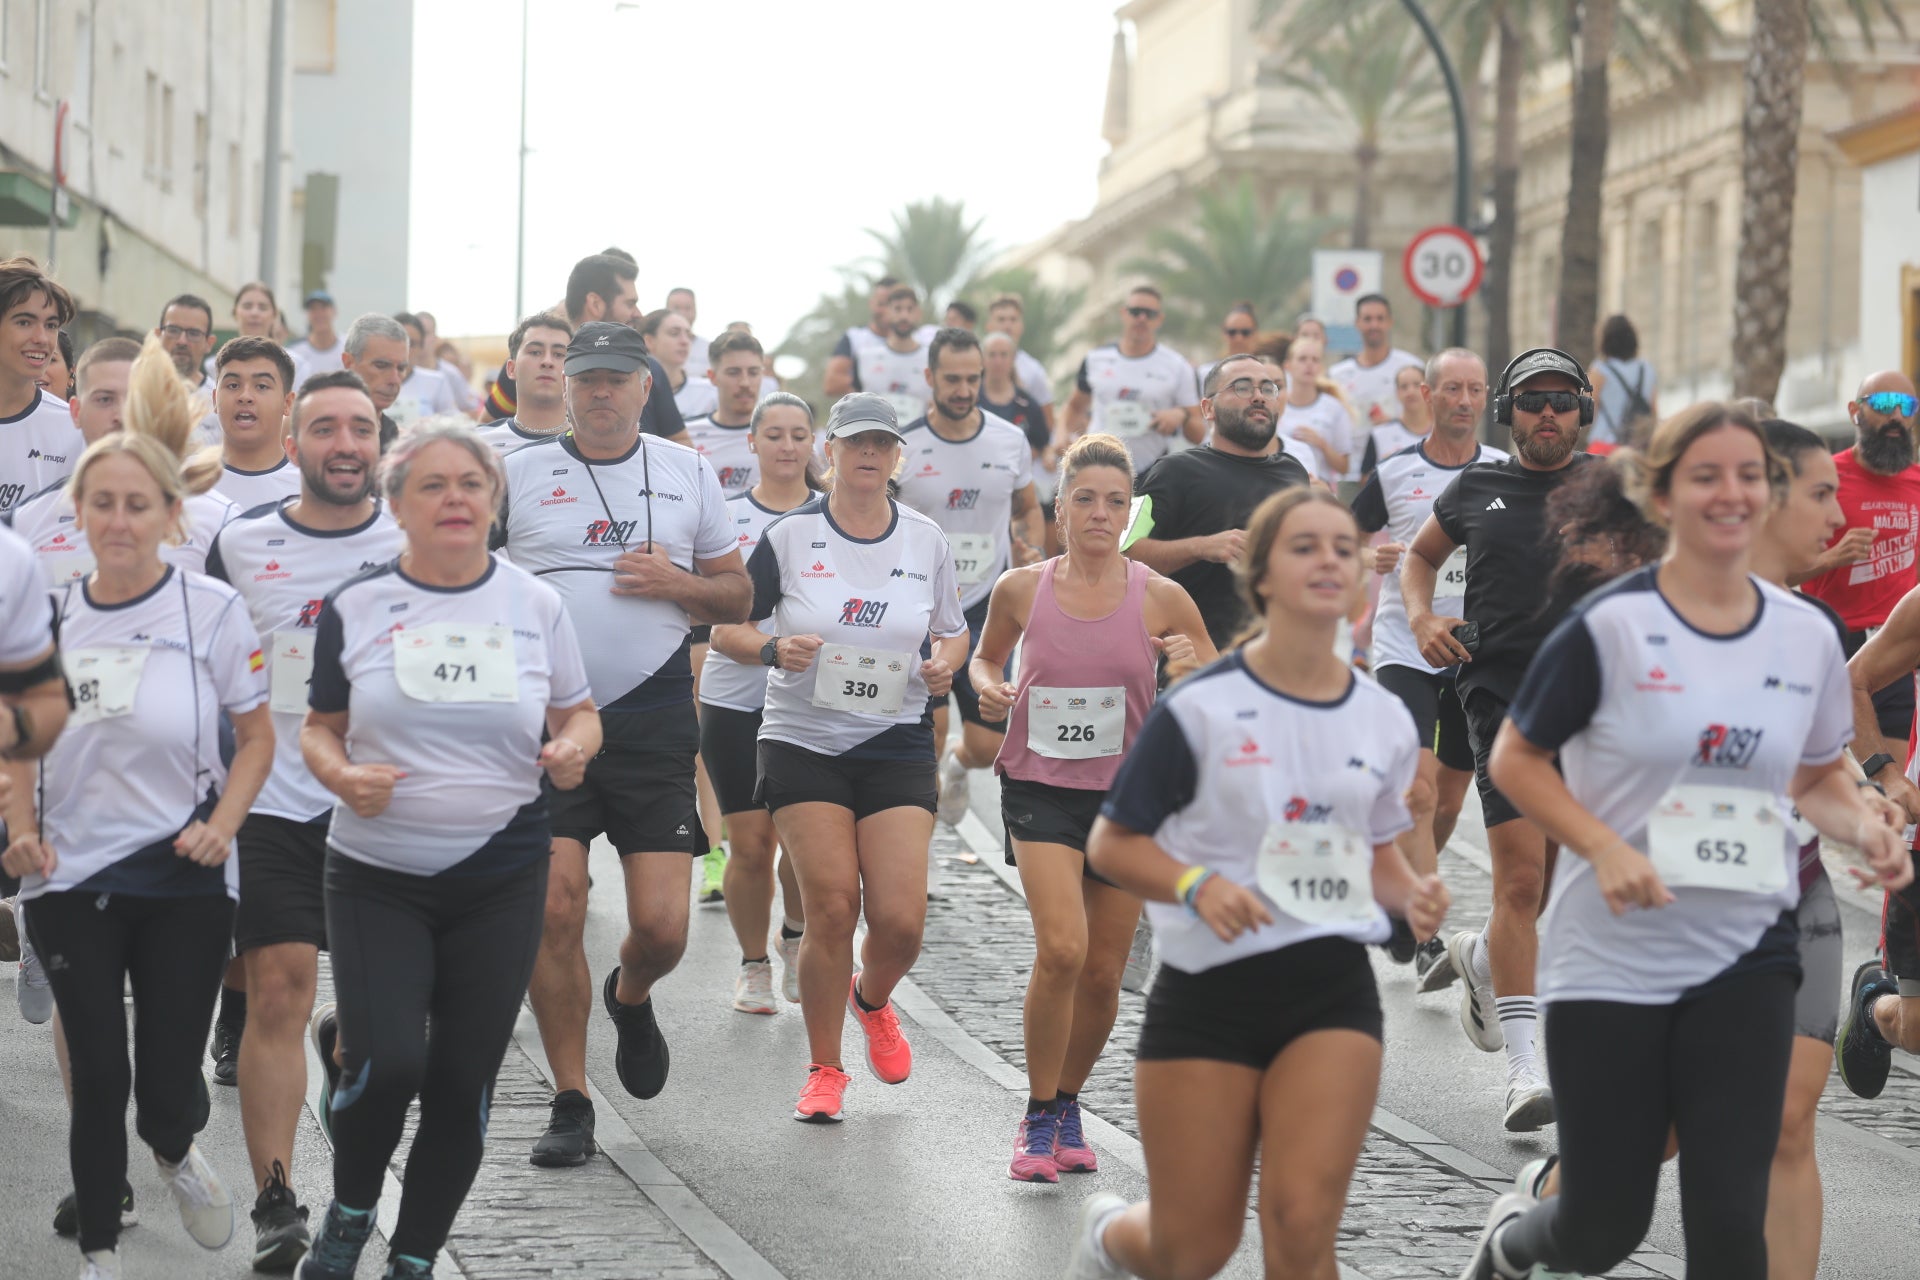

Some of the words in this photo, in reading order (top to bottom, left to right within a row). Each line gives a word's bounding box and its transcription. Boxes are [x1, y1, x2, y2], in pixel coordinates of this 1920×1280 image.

[1422, 252, 1465, 278] 30
[540, 496, 579, 507] Santander
[800, 571, 836, 579] Santander
[433, 662, 478, 683] 471
[842, 679, 879, 699] 330
[1057, 724, 1096, 742] 226
[1695, 838, 1748, 866] 652
[1288, 877, 1350, 900] 1100
